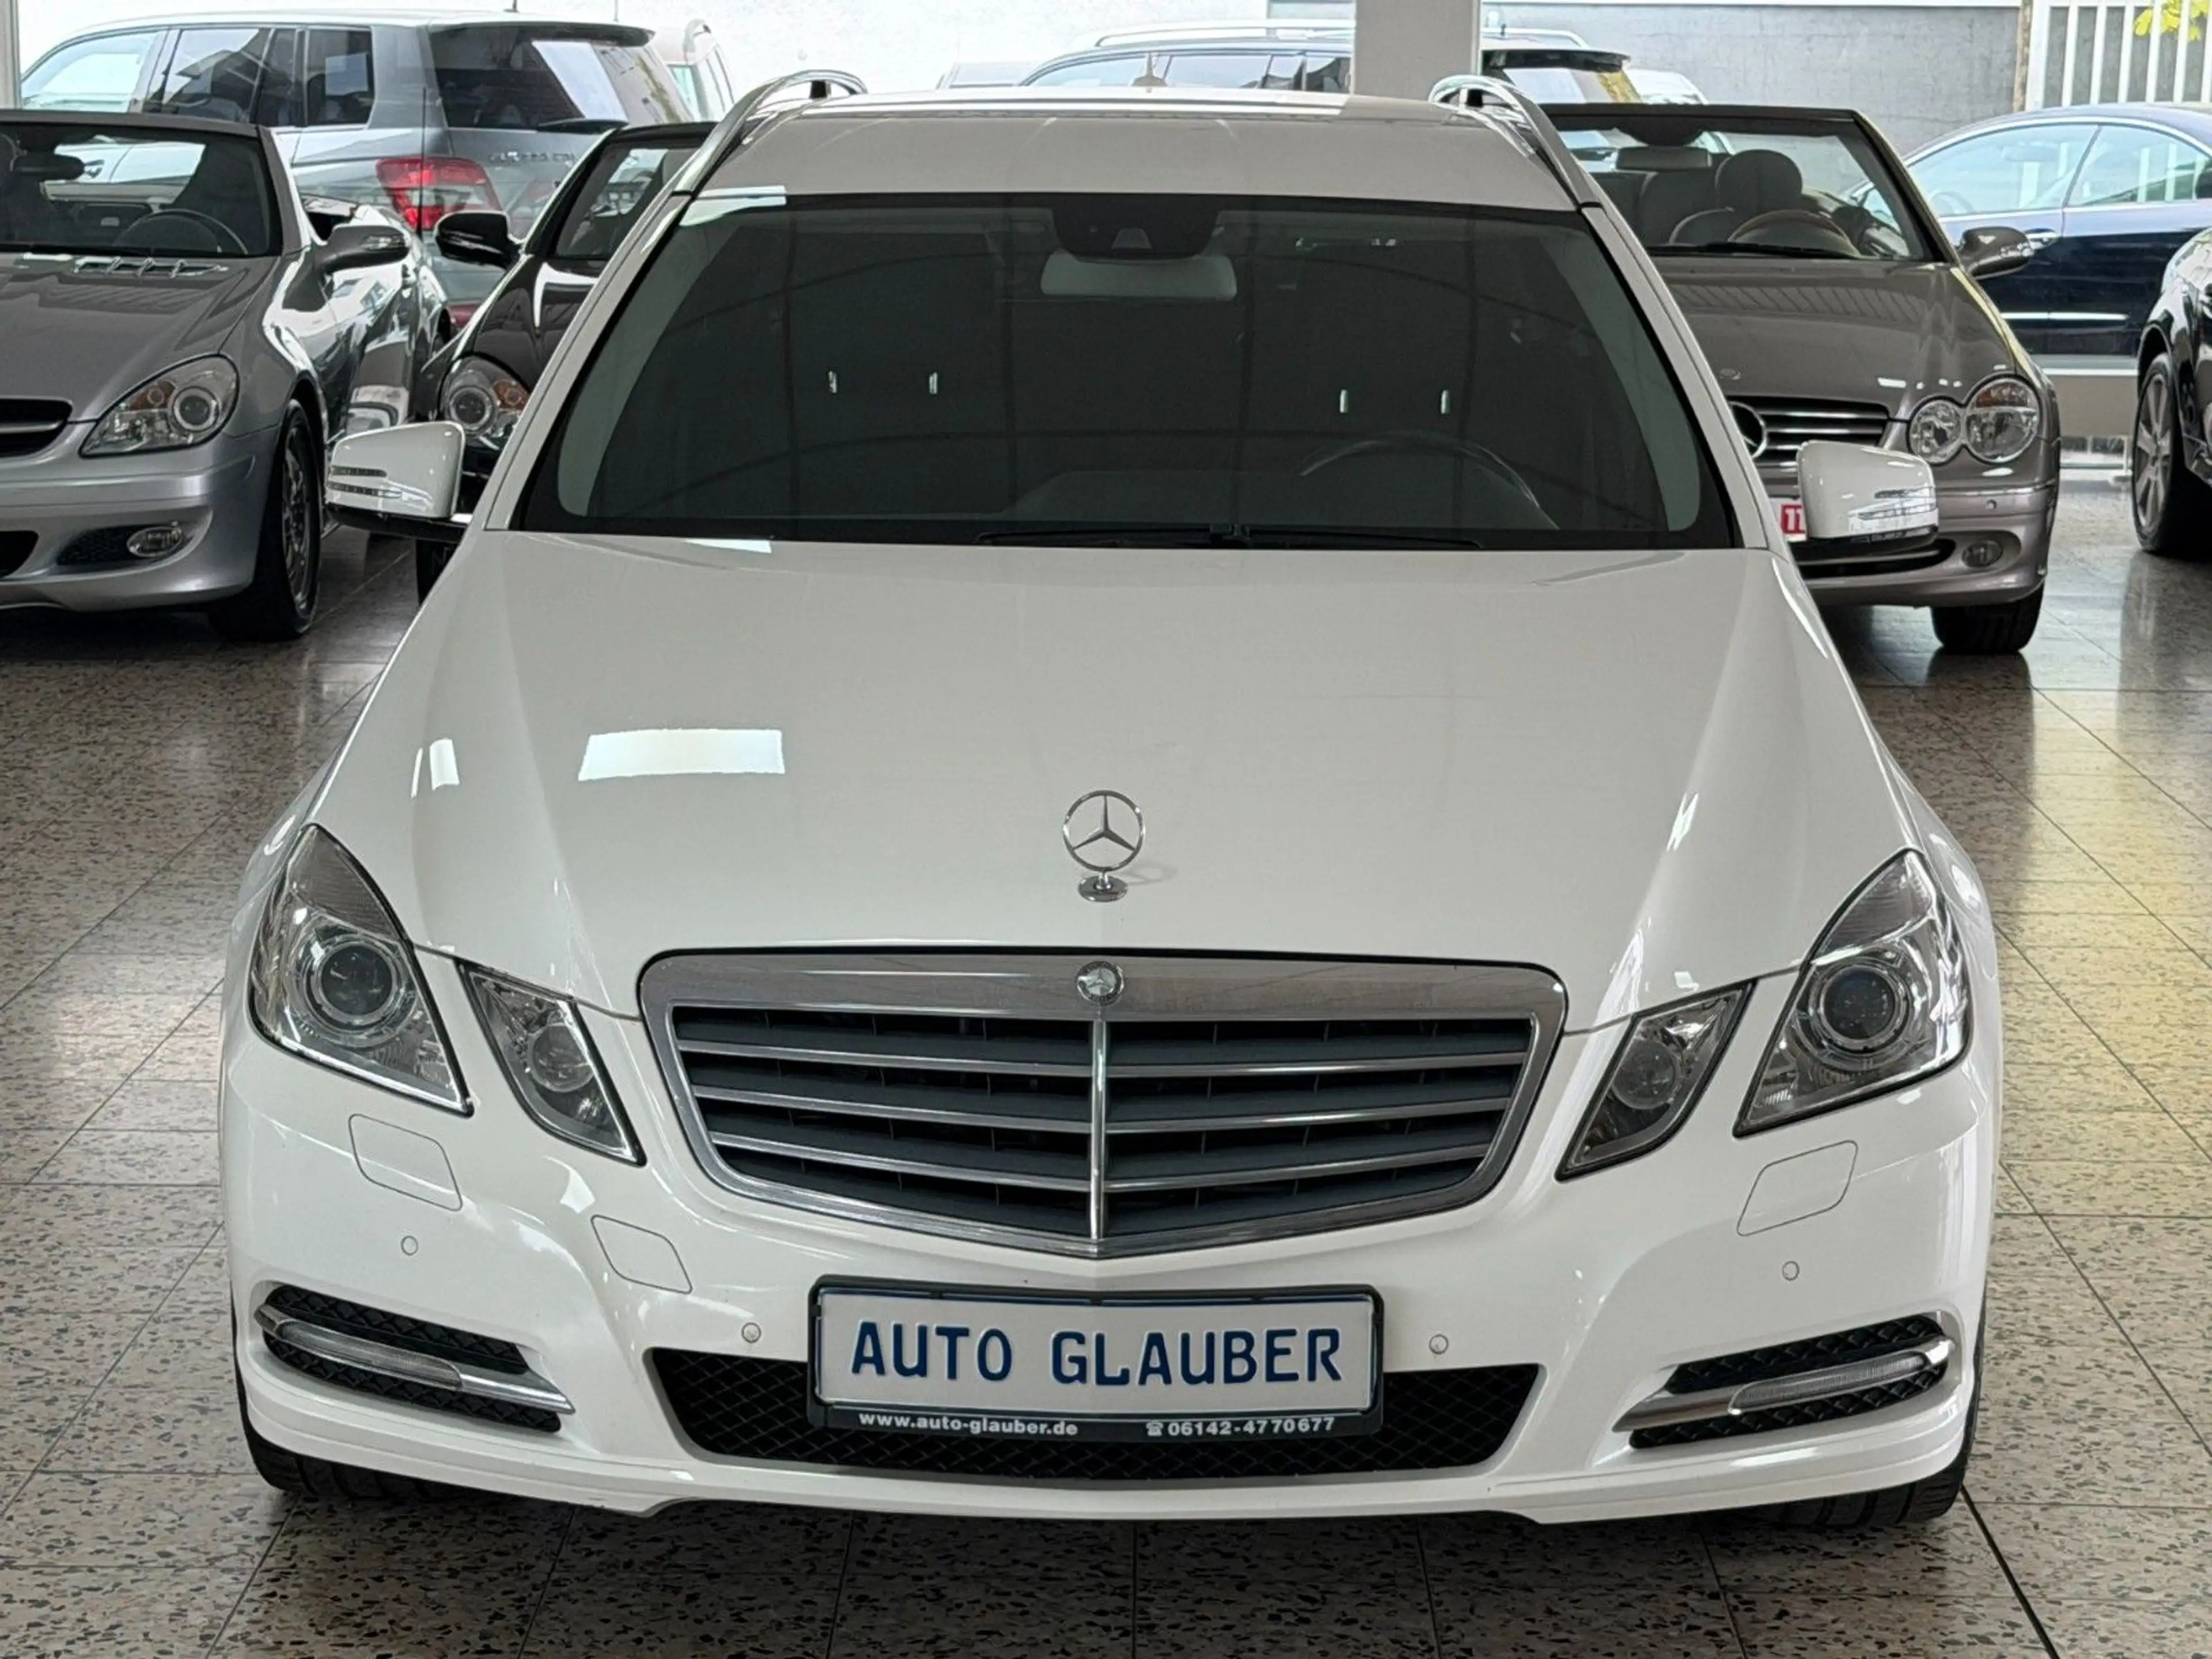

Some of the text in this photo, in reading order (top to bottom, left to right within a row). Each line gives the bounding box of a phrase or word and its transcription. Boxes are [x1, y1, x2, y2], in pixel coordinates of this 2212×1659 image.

[851, 1320, 1342, 1385] AUTO GLAUBER
[859, 1412, 1078, 1435] www.auto-glauber.de
[1168, 1416, 1335, 1436] 06142-4770677
